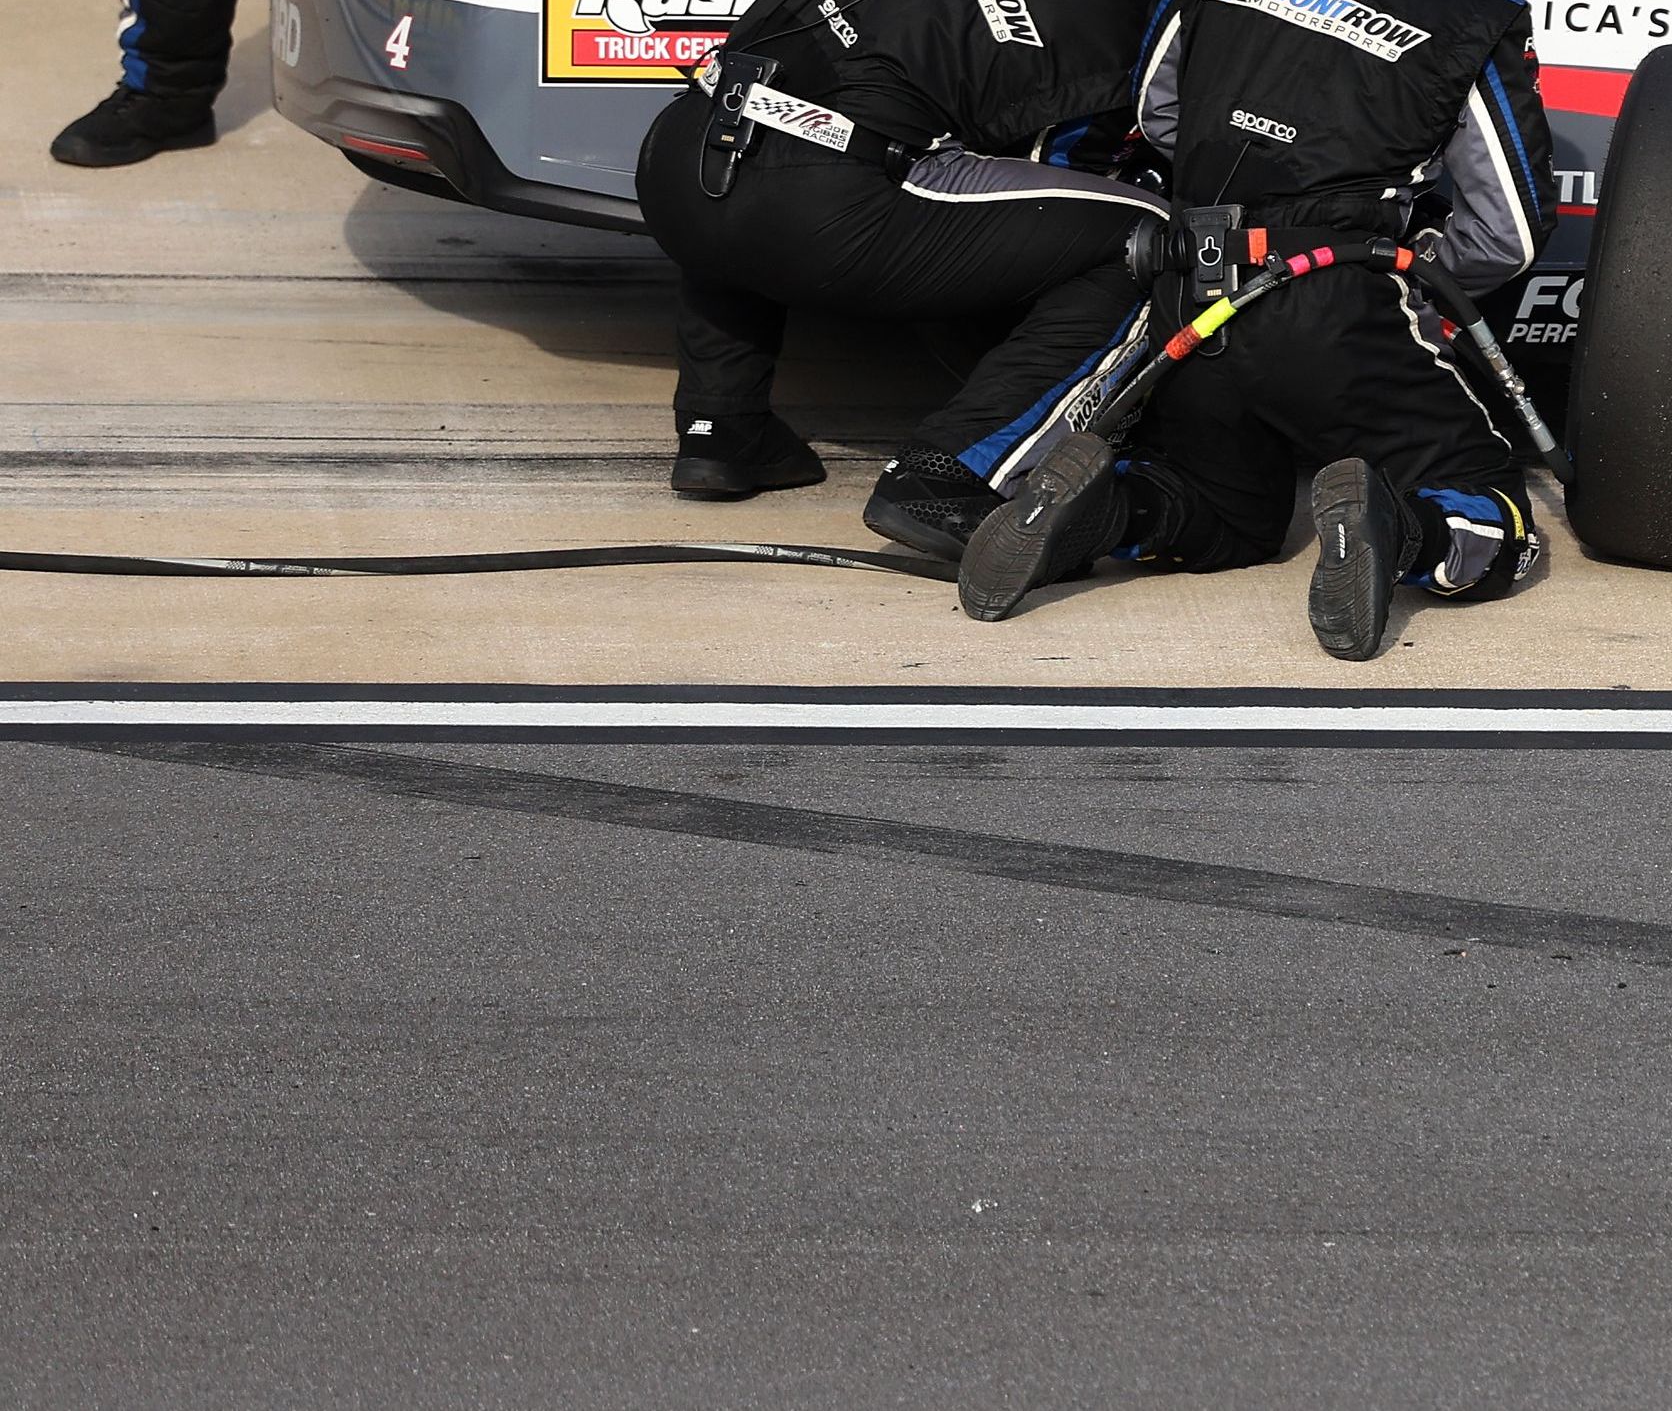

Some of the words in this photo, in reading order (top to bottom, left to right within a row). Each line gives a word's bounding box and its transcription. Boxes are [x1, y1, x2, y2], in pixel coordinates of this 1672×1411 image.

[1542, 0, 1672, 39] ICA'S
[384, 15, 414, 70] 4
[594, 36, 669, 61] TRUCK
[802, 129, 845, 149] RACING
[825, 123, 850, 136] JOE
[1229, 108, 1297, 144] sparco
